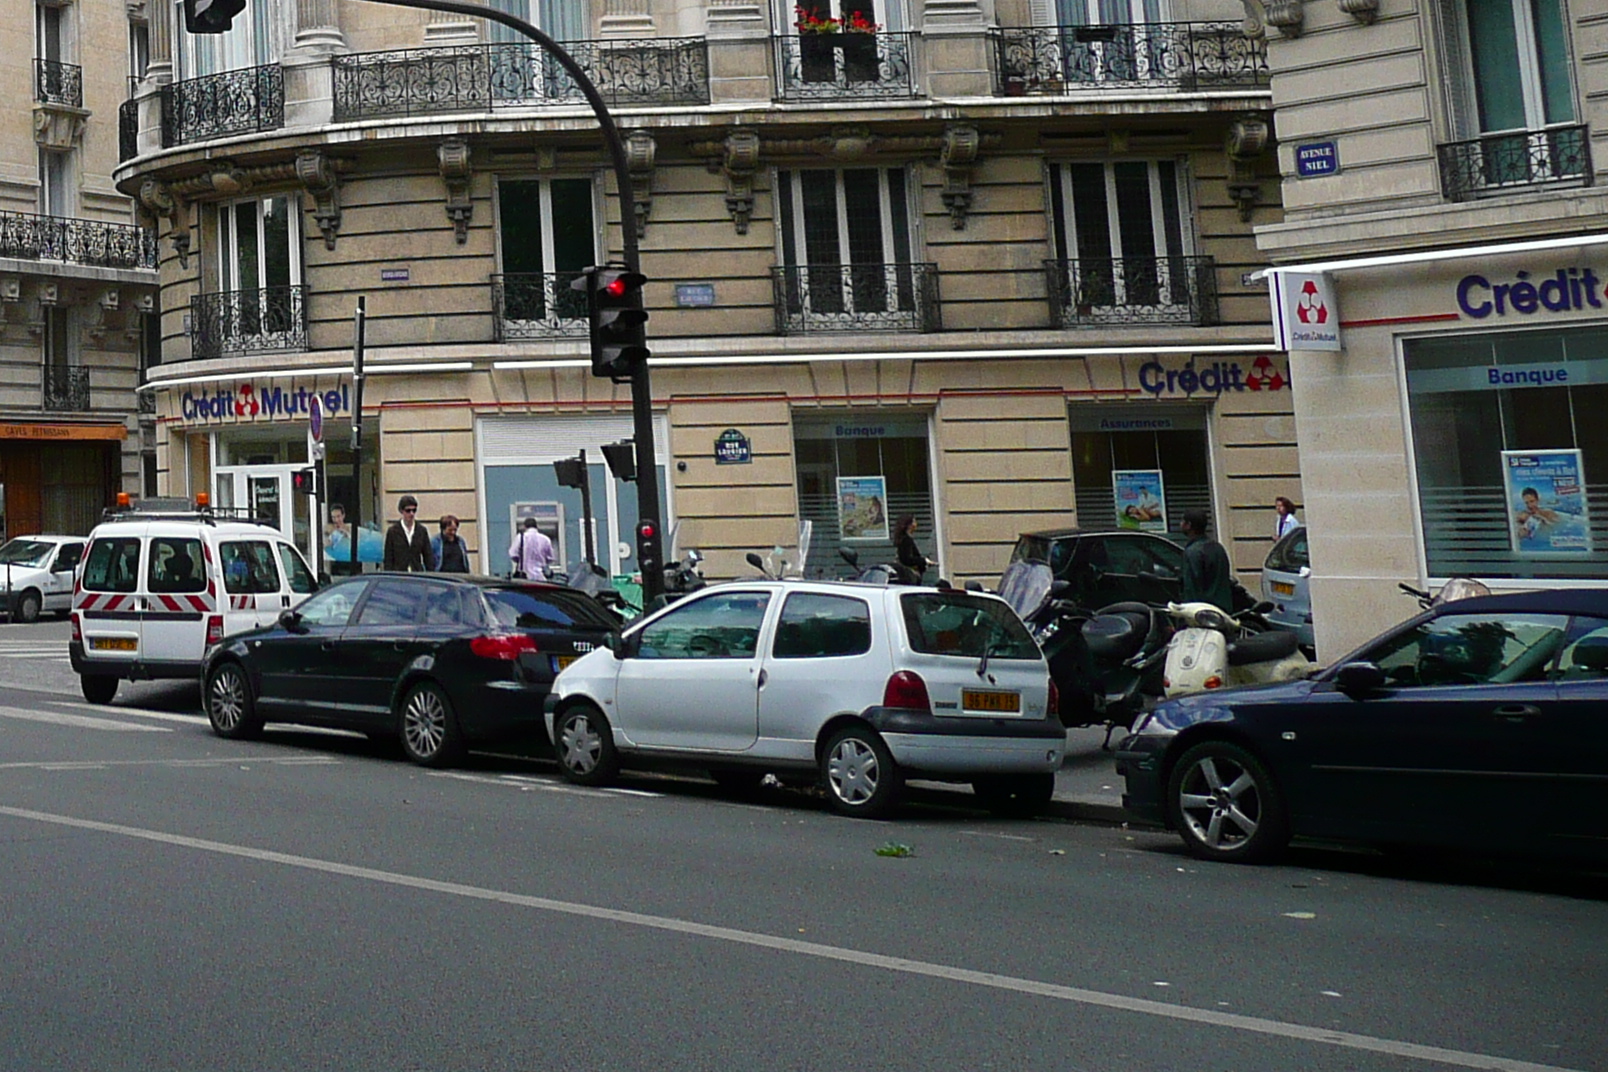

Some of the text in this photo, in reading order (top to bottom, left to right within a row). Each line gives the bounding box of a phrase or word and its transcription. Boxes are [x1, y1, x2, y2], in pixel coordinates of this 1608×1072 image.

[1300, 147, 1332, 159] AVENUE
[1305, 160, 1330, 171] NIEL
[1456, 267, 1602, 319] Crédit
[1138, 362, 1244, 393] Crédit
[1488, 368, 1568, 385] Banque
[182, 389, 234, 421] Crédit
[1100, 418, 1171, 429] Assurances
[835, 425, 885, 437] Banque
